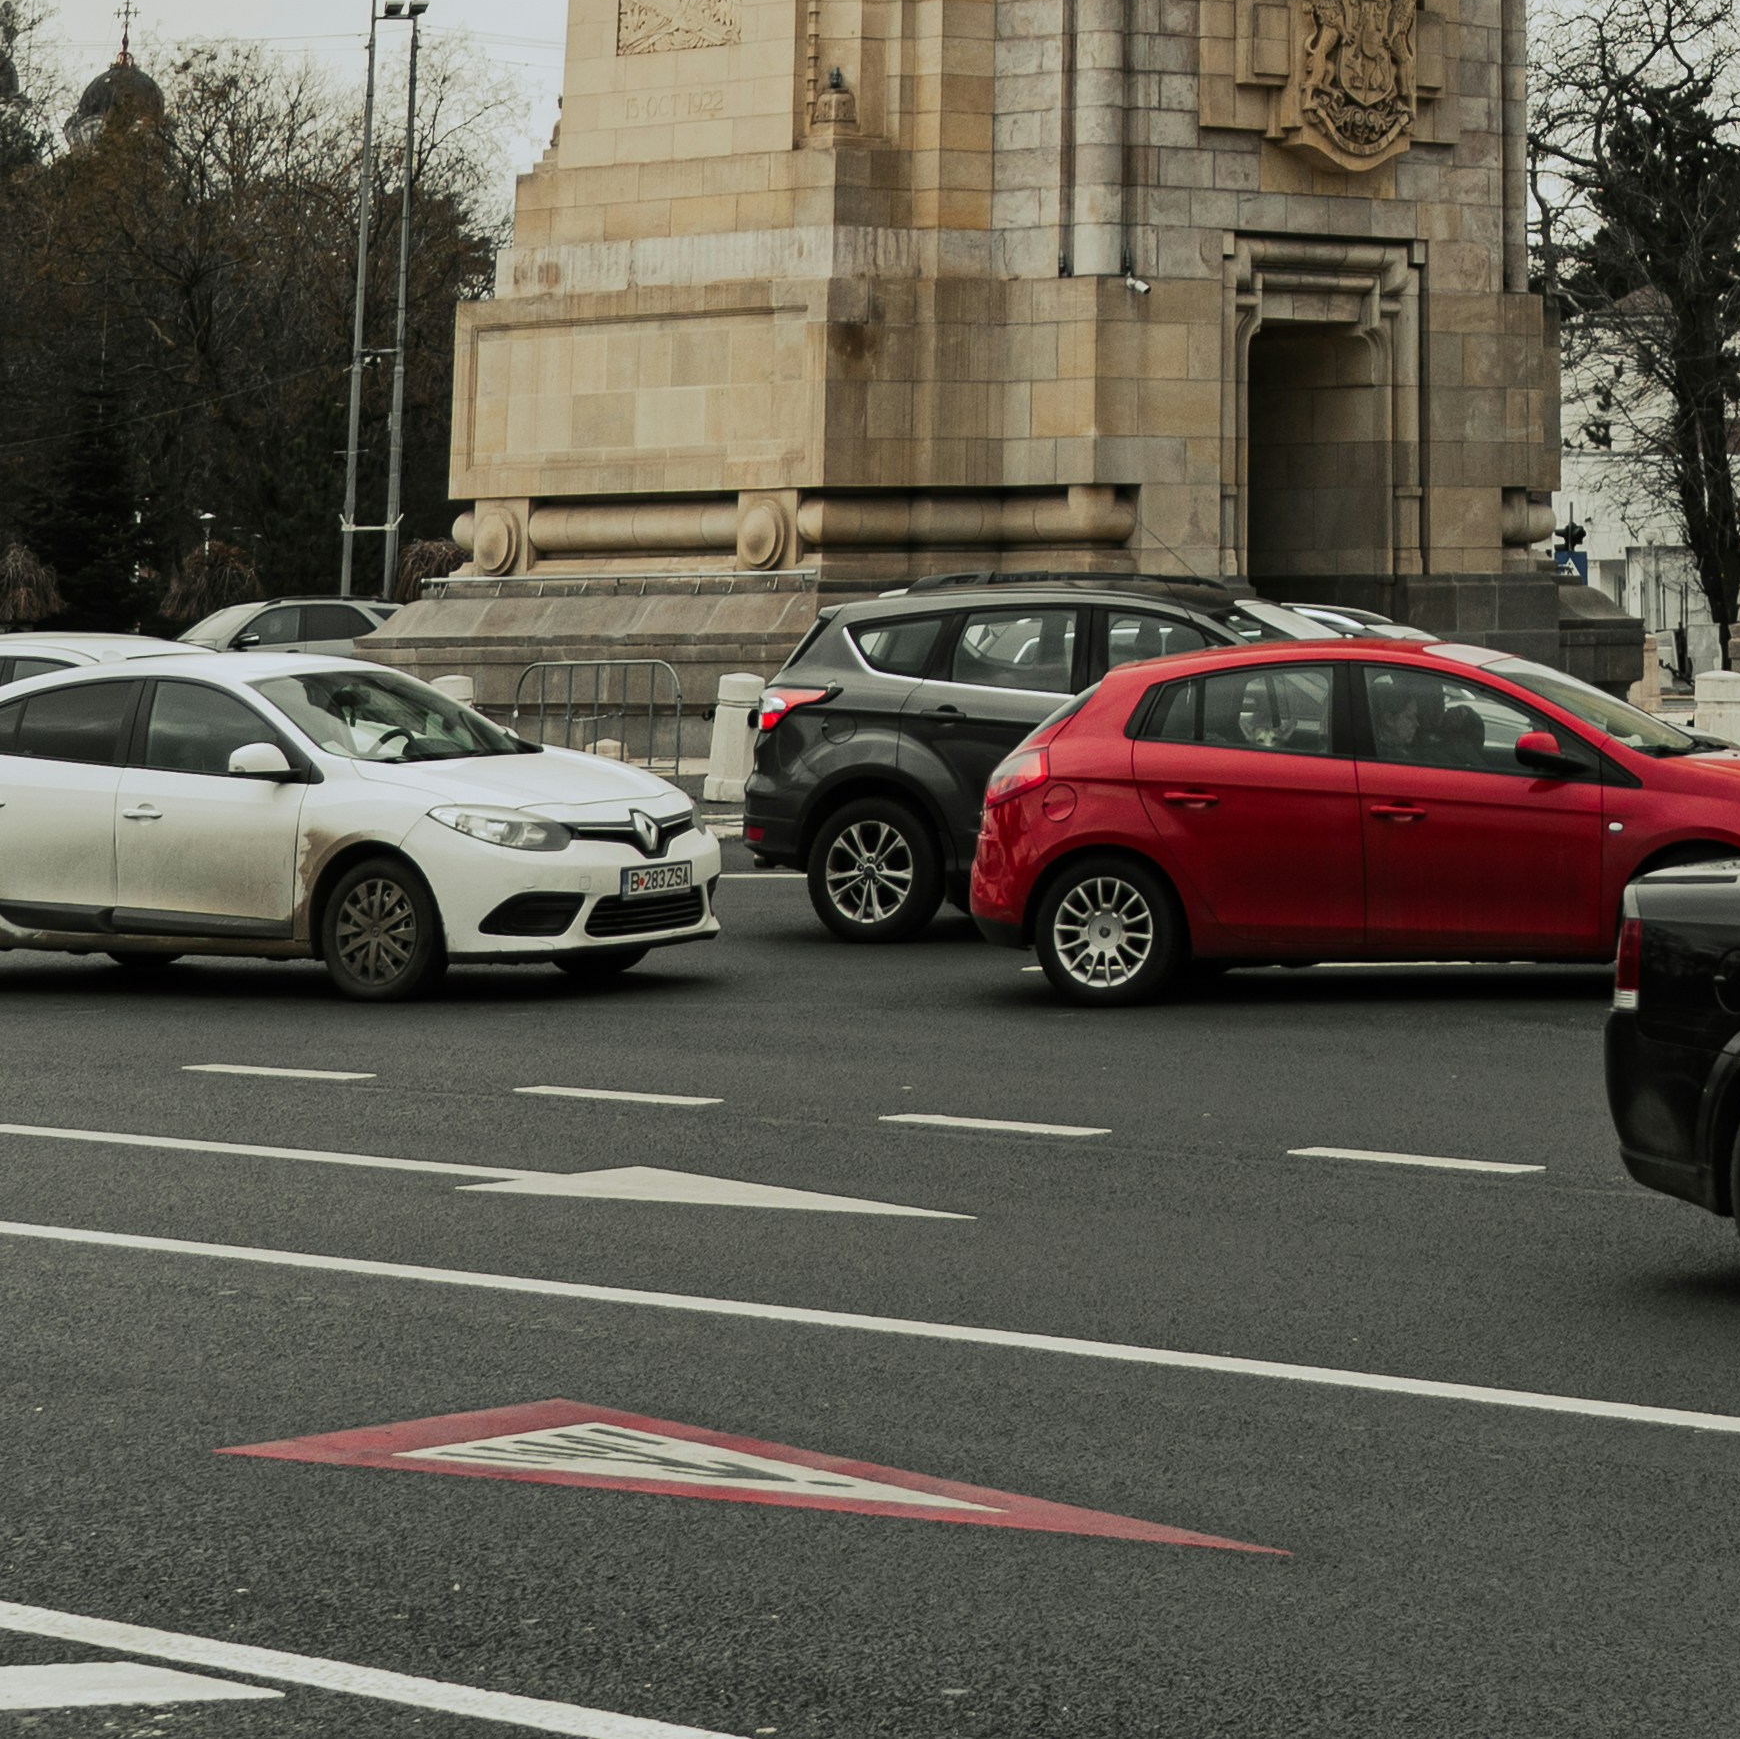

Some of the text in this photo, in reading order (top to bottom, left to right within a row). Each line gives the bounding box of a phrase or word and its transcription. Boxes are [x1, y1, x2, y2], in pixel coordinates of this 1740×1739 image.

[625, 90, 724, 120] 15 OCT 1922
[630, 866, 689, 892] B 283 ZSA
